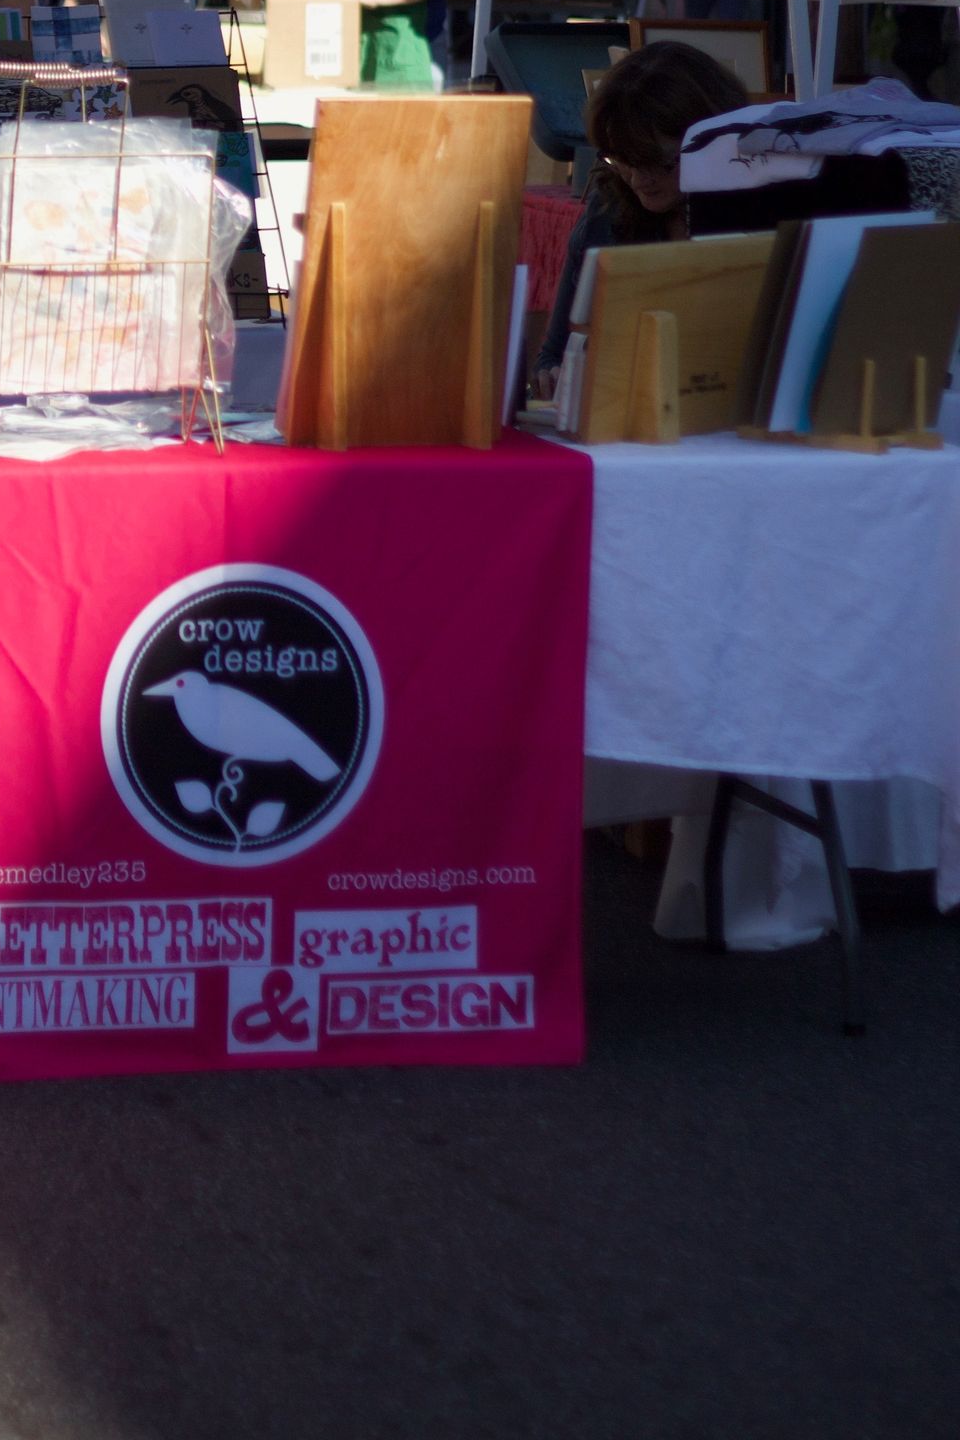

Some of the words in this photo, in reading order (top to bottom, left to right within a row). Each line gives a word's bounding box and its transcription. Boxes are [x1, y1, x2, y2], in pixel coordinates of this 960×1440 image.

[178, 618, 265, 643] crow
[203, 643, 339, 678] designs
[327, 864, 537, 892] crowdesigns.com
[298, 911, 472, 969] graphic
[231, 969, 310, 1045] &
[328, 981, 528, 1031] DESIGN
